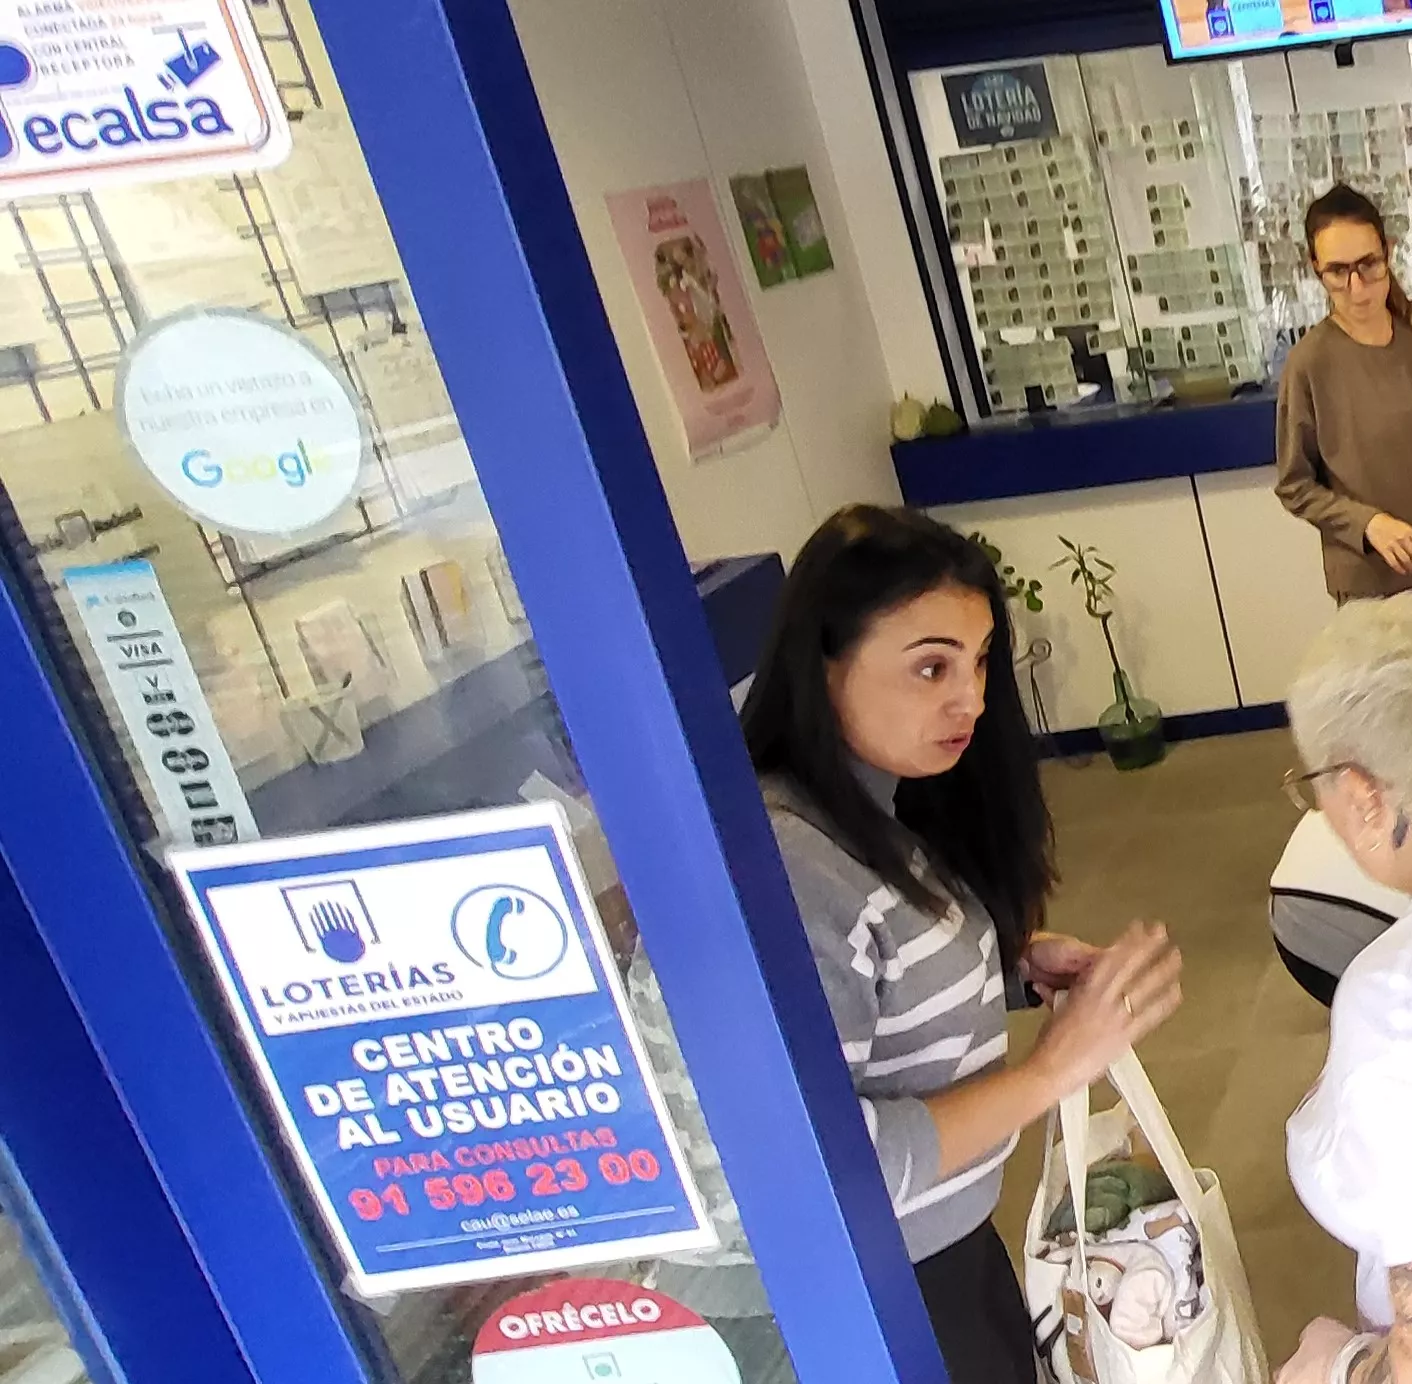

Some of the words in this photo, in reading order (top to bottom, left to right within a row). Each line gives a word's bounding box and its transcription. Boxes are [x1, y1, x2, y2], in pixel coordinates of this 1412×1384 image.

[0, 84, 233, 158] ecalsa
[181, 438, 331, 487] Google
[260, 962, 456, 1008] LOTERÍAS
[274, 1014, 284, 1025] Y
[288, 1003, 366, 1022] APUESTAS
[371, 998, 400, 1012] DEL
[403, 990, 464, 1007] ESTADO
[351, 1016, 544, 1072] CENTRO
[303, 1077, 376, 1118] DE
[385, 1042, 623, 1109] ATENCIÓN
[336, 1112, 401, 1152] AL
[409, 1083, 622, 1139] USUARIO
[373, 1150, 451, 1180] PARA
[455, 1126, 617, 1169] CONSULTAS
[348, 1185, 411, 1222] 91
[422, 1169, 516, 1210] 596
[524, 1156, 589, 1198] 23
[599, 1148, 660, 1185] 00
[499, 1298, 662, 1340] OFRÉCELO
